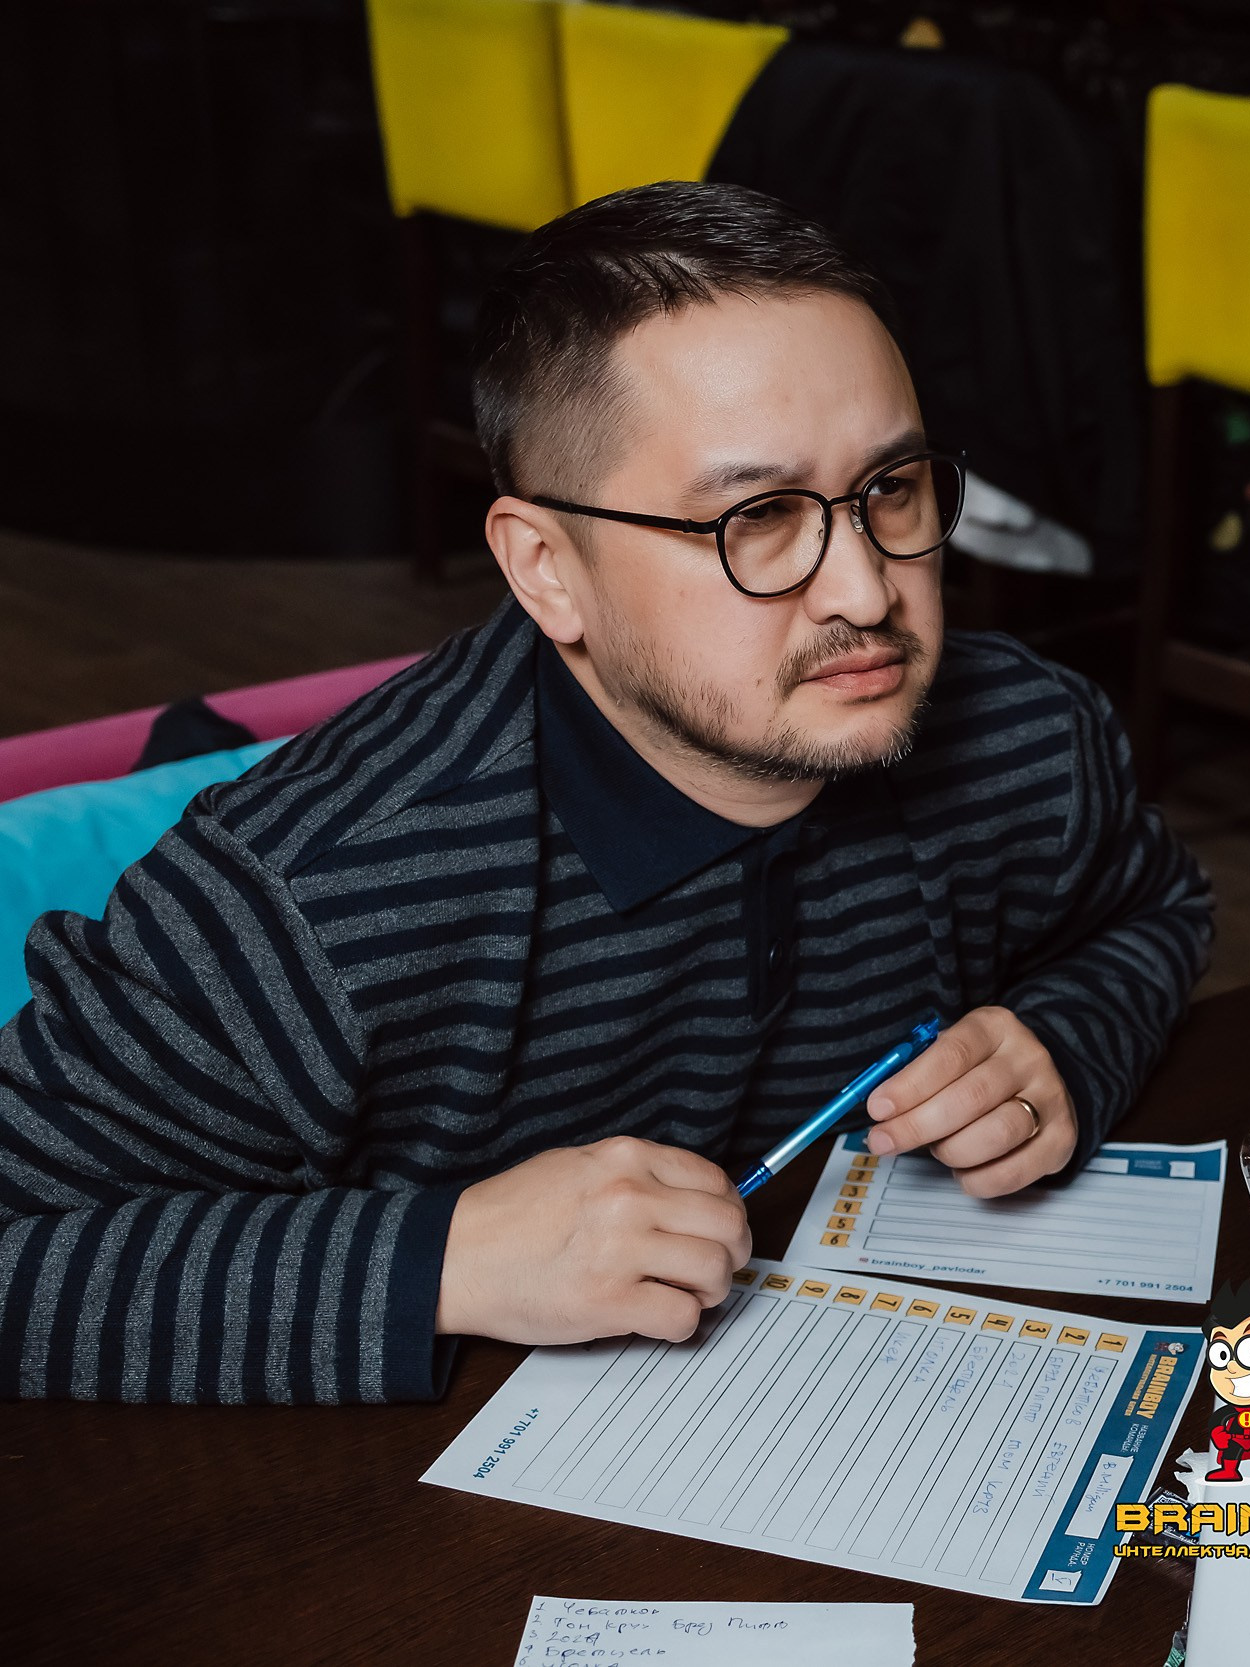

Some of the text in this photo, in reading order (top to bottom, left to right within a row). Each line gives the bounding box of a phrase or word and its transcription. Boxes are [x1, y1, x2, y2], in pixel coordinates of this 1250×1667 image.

[862, 1156, 869, 1165] 1
[856, 1171, 865, 1181] 2
[848, 1186, 858, 1197] 3
[843, 1201, 853, 1213] 4
[837, 1218, 846, 1229] 5
[830, 1234, 839, 1246] 6
[871, 1258, 987, 1275] brainboy_pavlodar
[765, 1276, 788, 1289] 10
[1115, 1279, 1135, 1287] 701
[1140, 1281, 1161, 1289] 991
[1165, 1283, 1193, 1292] 2504
[805, 1285, 824, 1293] 9
[840, 1291, 861, 1300] 8
[877, 1298, 897, 1308] 7
[913, 1304, 933, 1313] 6
[950, 1311, 971, 1320] 5
[987, 1317, 1009, 1327] 4
[1026, 1324, 1047, 1334] 3
[1065, 1332, 1085, 1342] 2
[1102, 1338, 1123, 1346] 1
[1136, 1355, 1179, 1420] BRAINBOY
[473, 1407, 540, 1479] +7 701 991 2504
[1120, 1423, 1140, 1453] КОМАНДЫ:
[1132, 1424, 1149, 1452] НАЗВАНИЕ
[1067, 1541, 1085, 1568] РАУНДА:
[1080, 1543, 1096, 1567] НОМЕР
